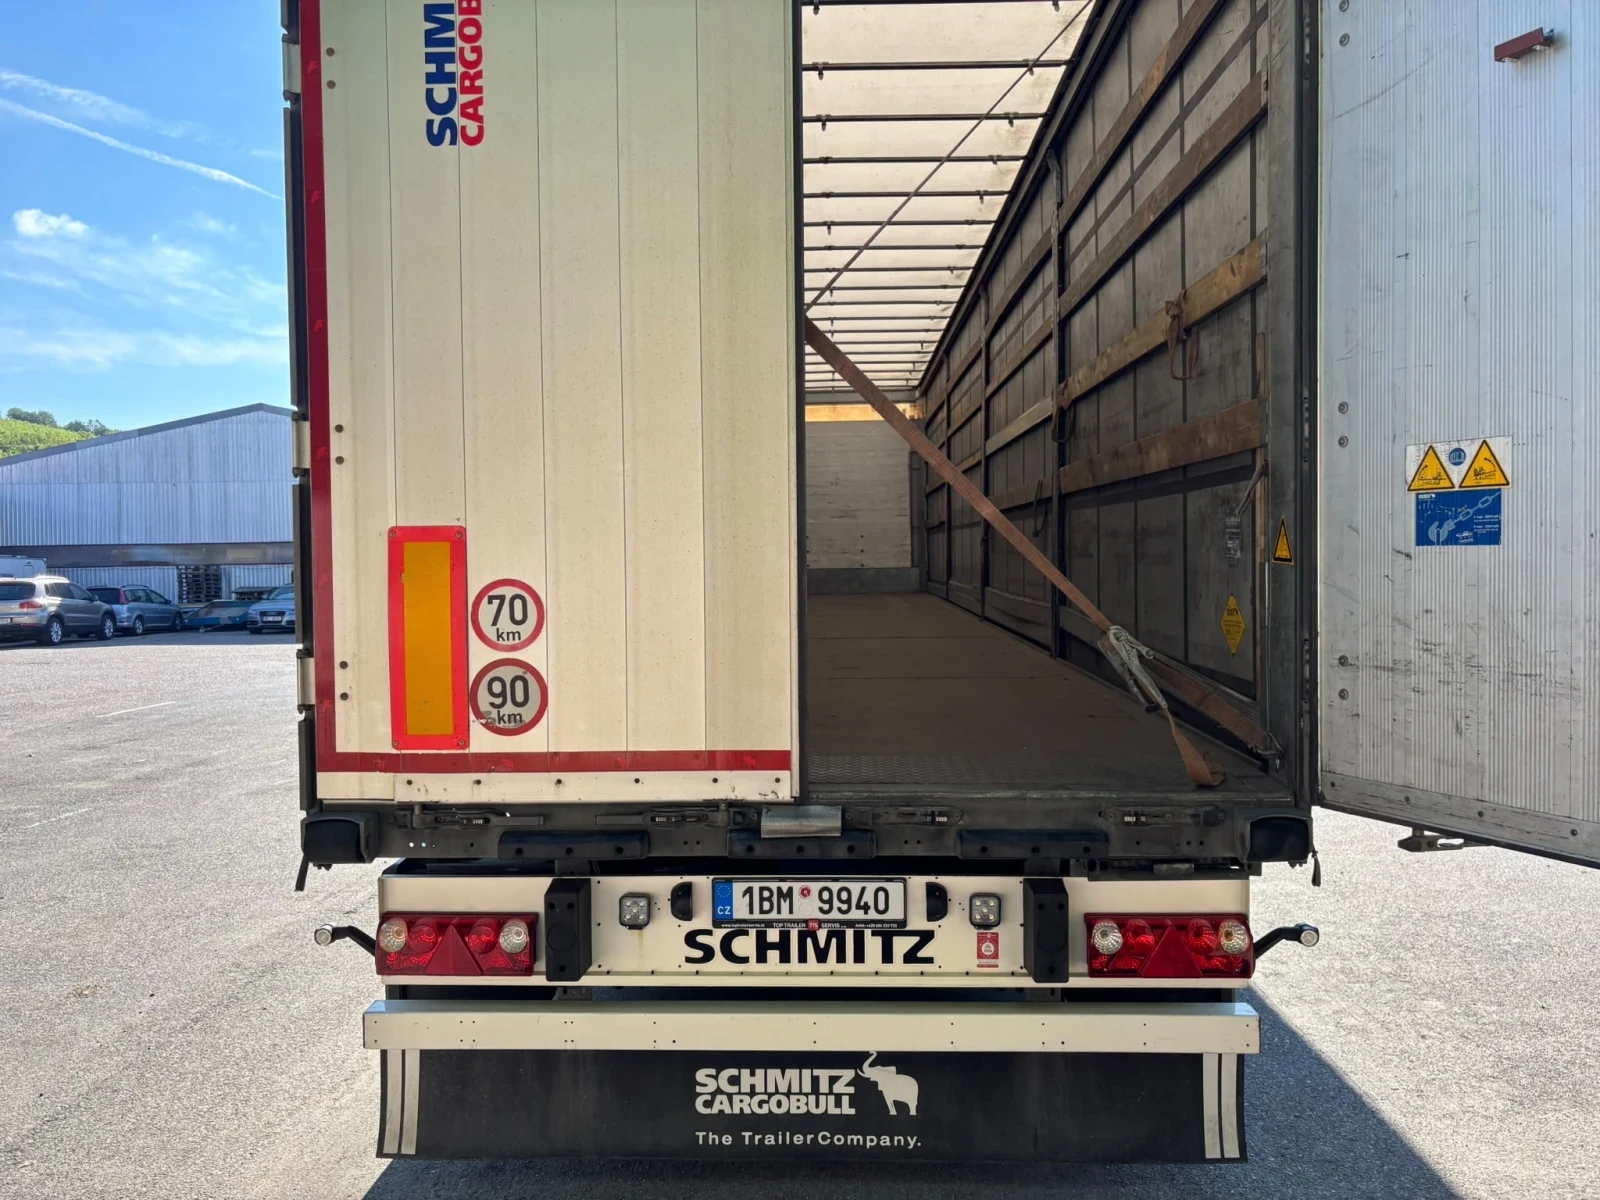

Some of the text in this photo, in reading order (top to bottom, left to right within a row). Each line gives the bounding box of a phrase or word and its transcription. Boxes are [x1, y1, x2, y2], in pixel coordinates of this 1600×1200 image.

[423, 3, 457, 147] SCHM
[487, 594, 528, 626] 70
[496, 628, 521, 641] km
[487, 675, 530, 710] 90
[497, 710, 523, 725] km
[717, 906, 731, 915] CZ
[742, 886, 890, 915] 1BM 9940
[684, 929, 935, 965] SCHMITZ
[695, 1068, 856, 1094] SCHMITZ
[695, 1094, 856, 1115] CARGOBULL
[695, 1131, 733, 1145] The
